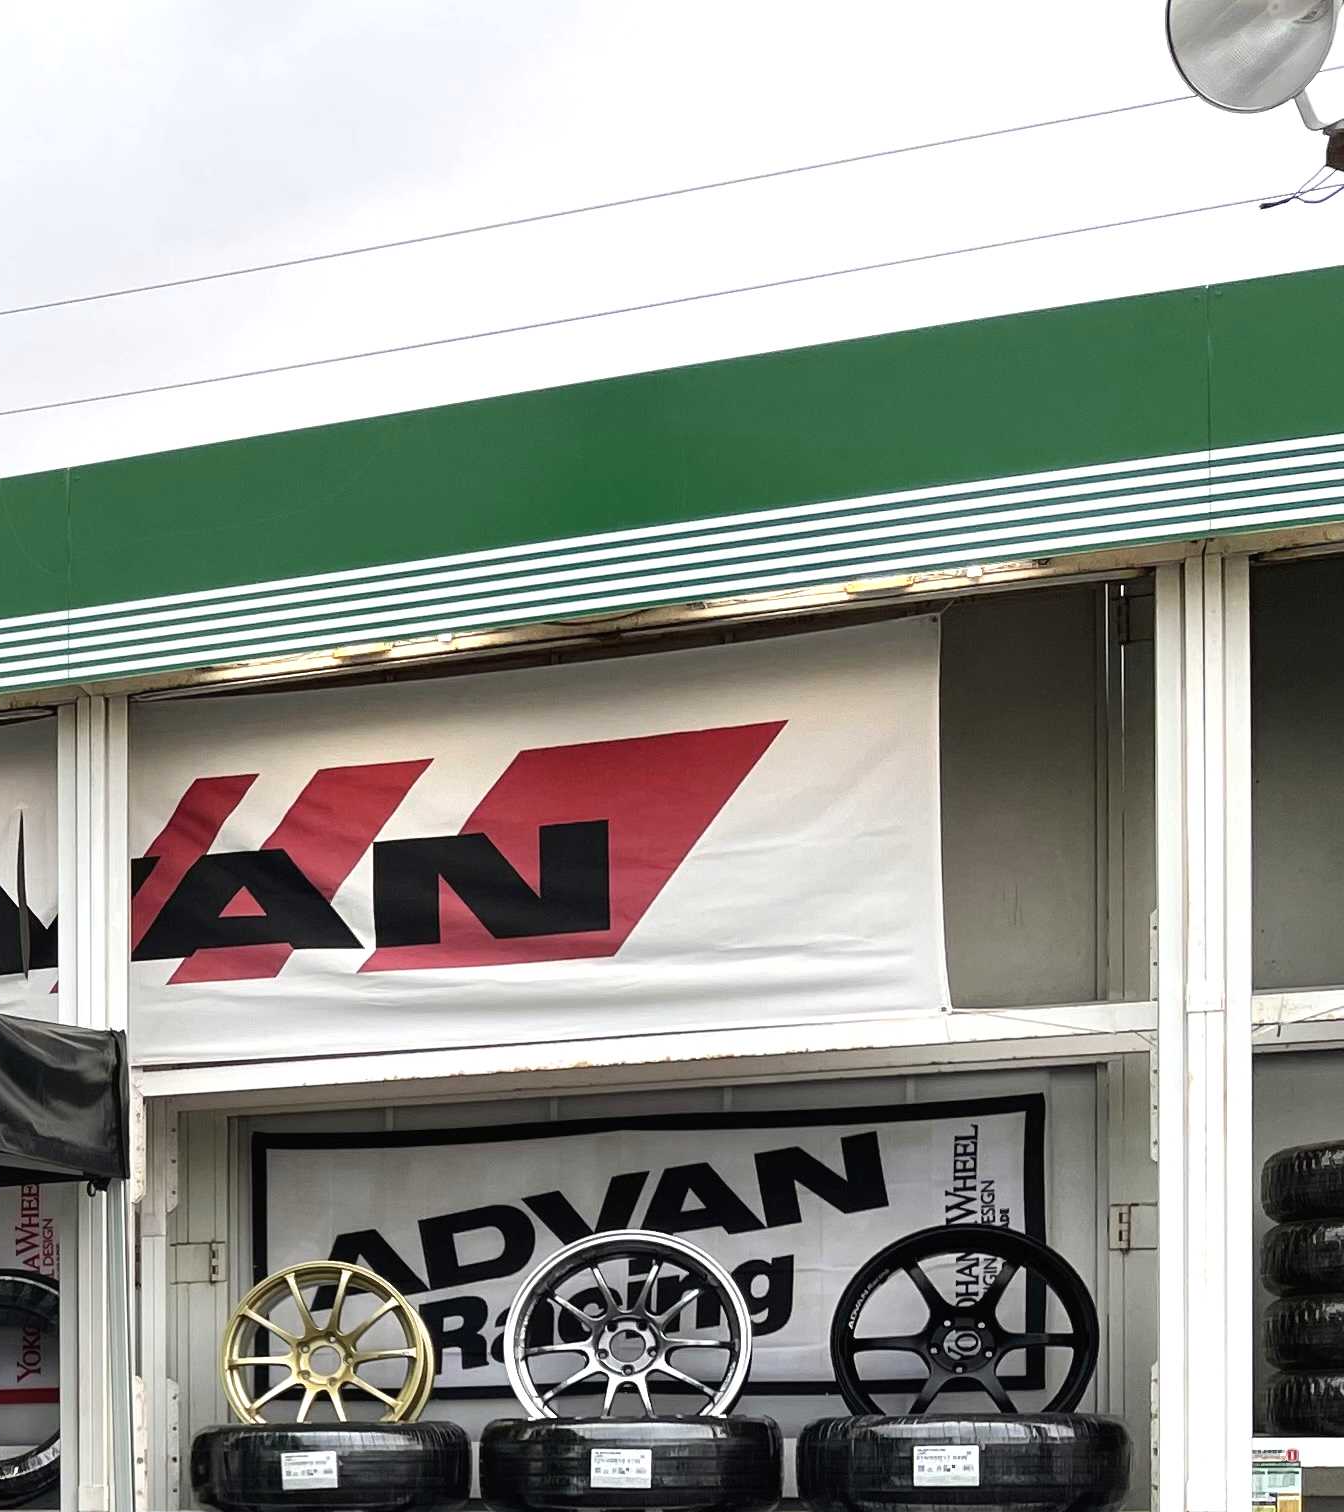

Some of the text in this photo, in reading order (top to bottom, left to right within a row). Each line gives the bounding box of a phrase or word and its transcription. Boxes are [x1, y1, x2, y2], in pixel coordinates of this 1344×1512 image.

[15, 1184, 40, 1257] WHEE
[310, 1129, 890, 1312] ADVAN
[981, 1179, 996, 1225] ESIGN
